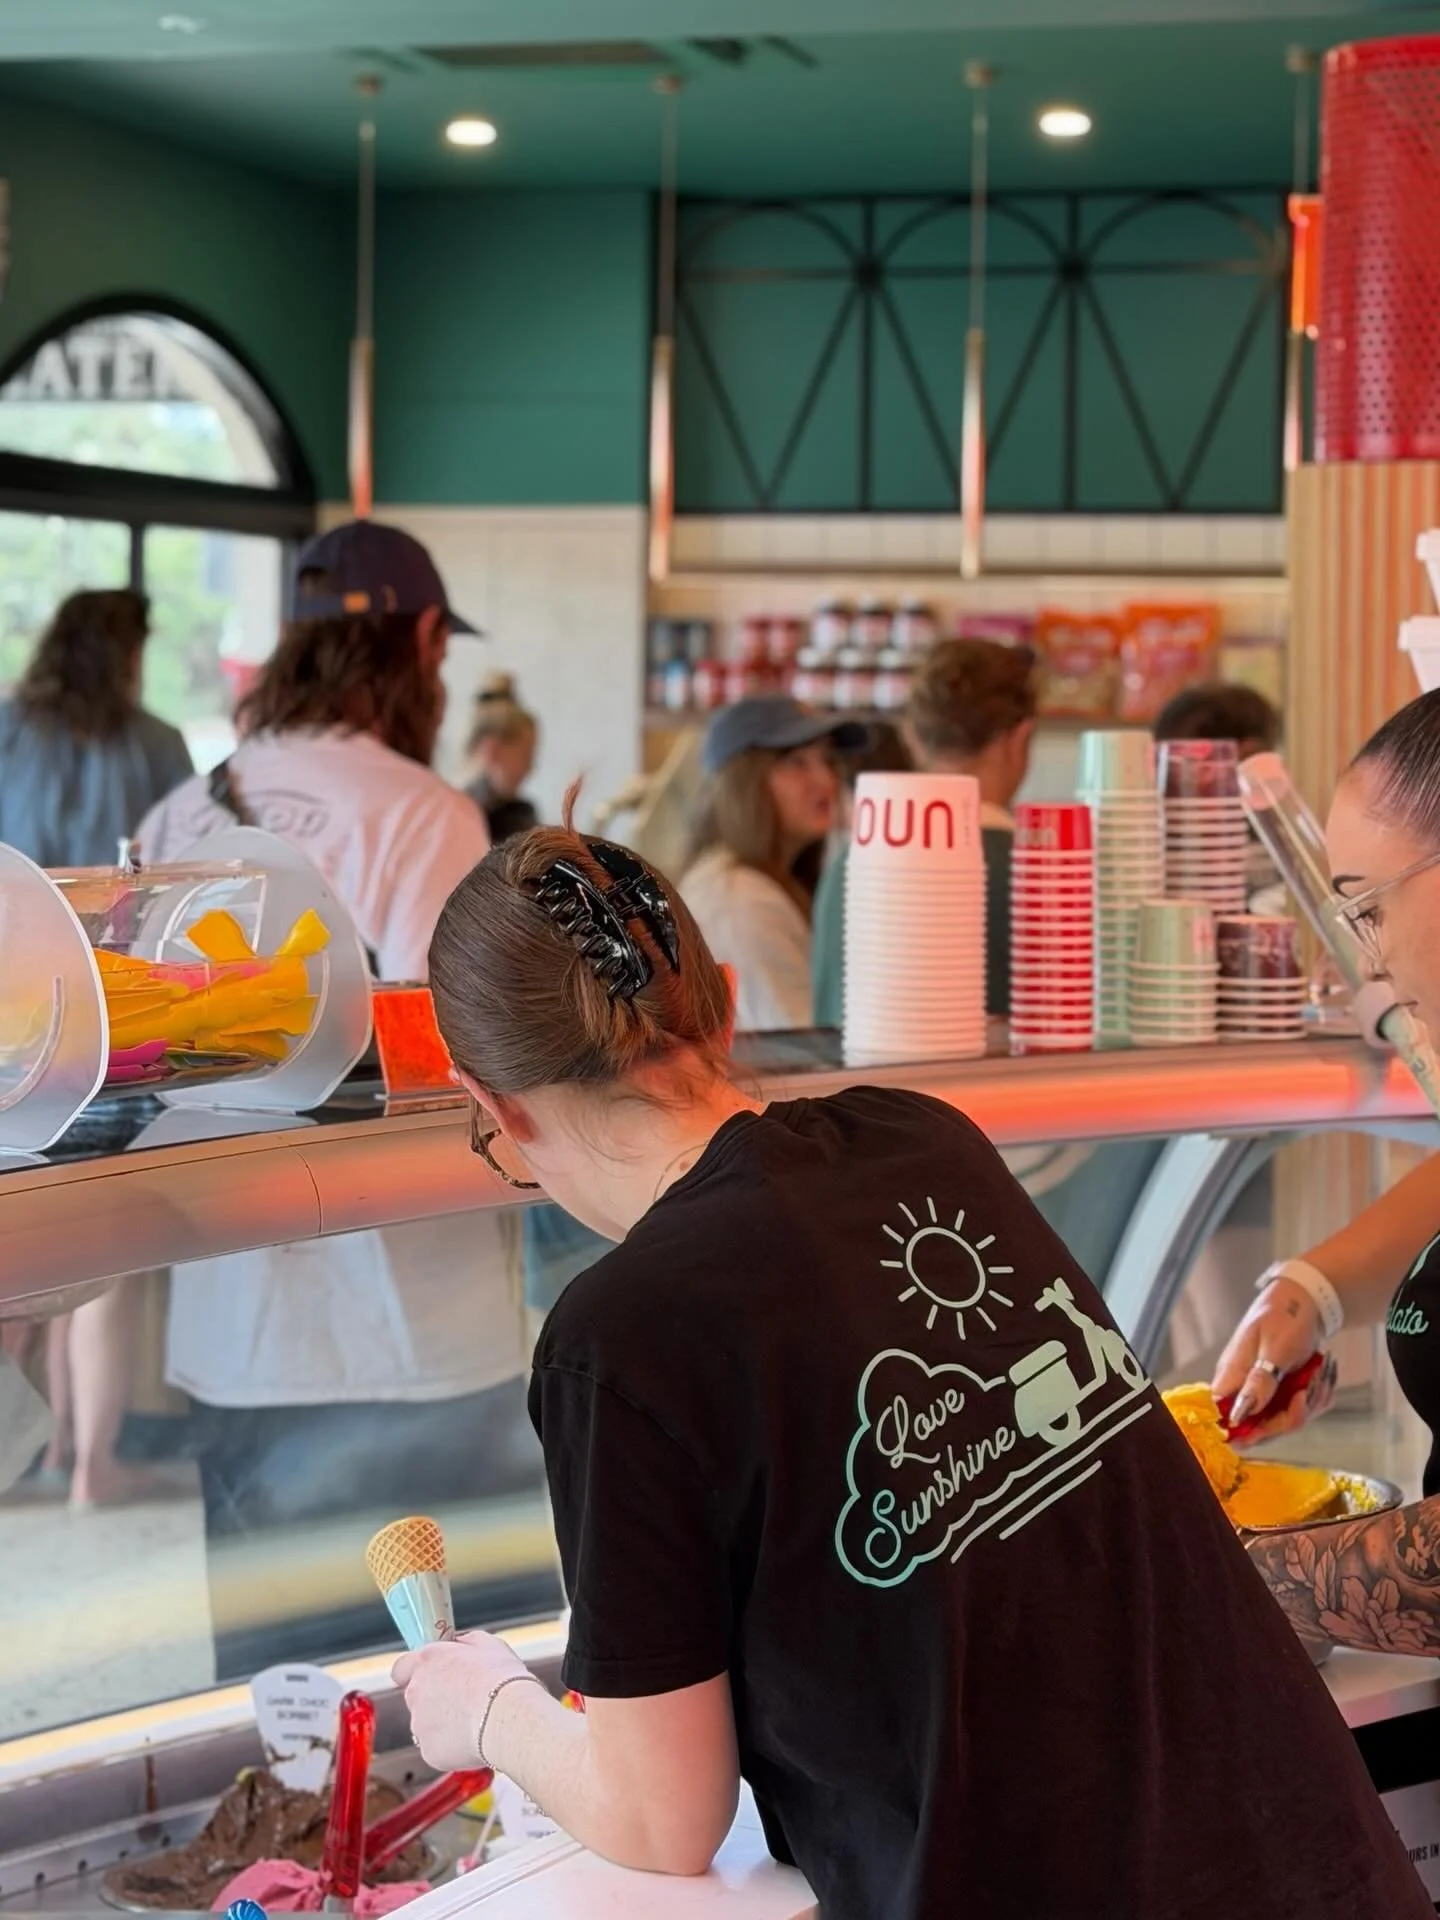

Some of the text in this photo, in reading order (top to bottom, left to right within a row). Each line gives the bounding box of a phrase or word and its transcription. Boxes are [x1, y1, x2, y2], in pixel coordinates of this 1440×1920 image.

[1387, 1287, 1430, 1335] lato
[876, 1387, 965, 1470] Love
[864, 1425, 1017, 1569] Sunshine
